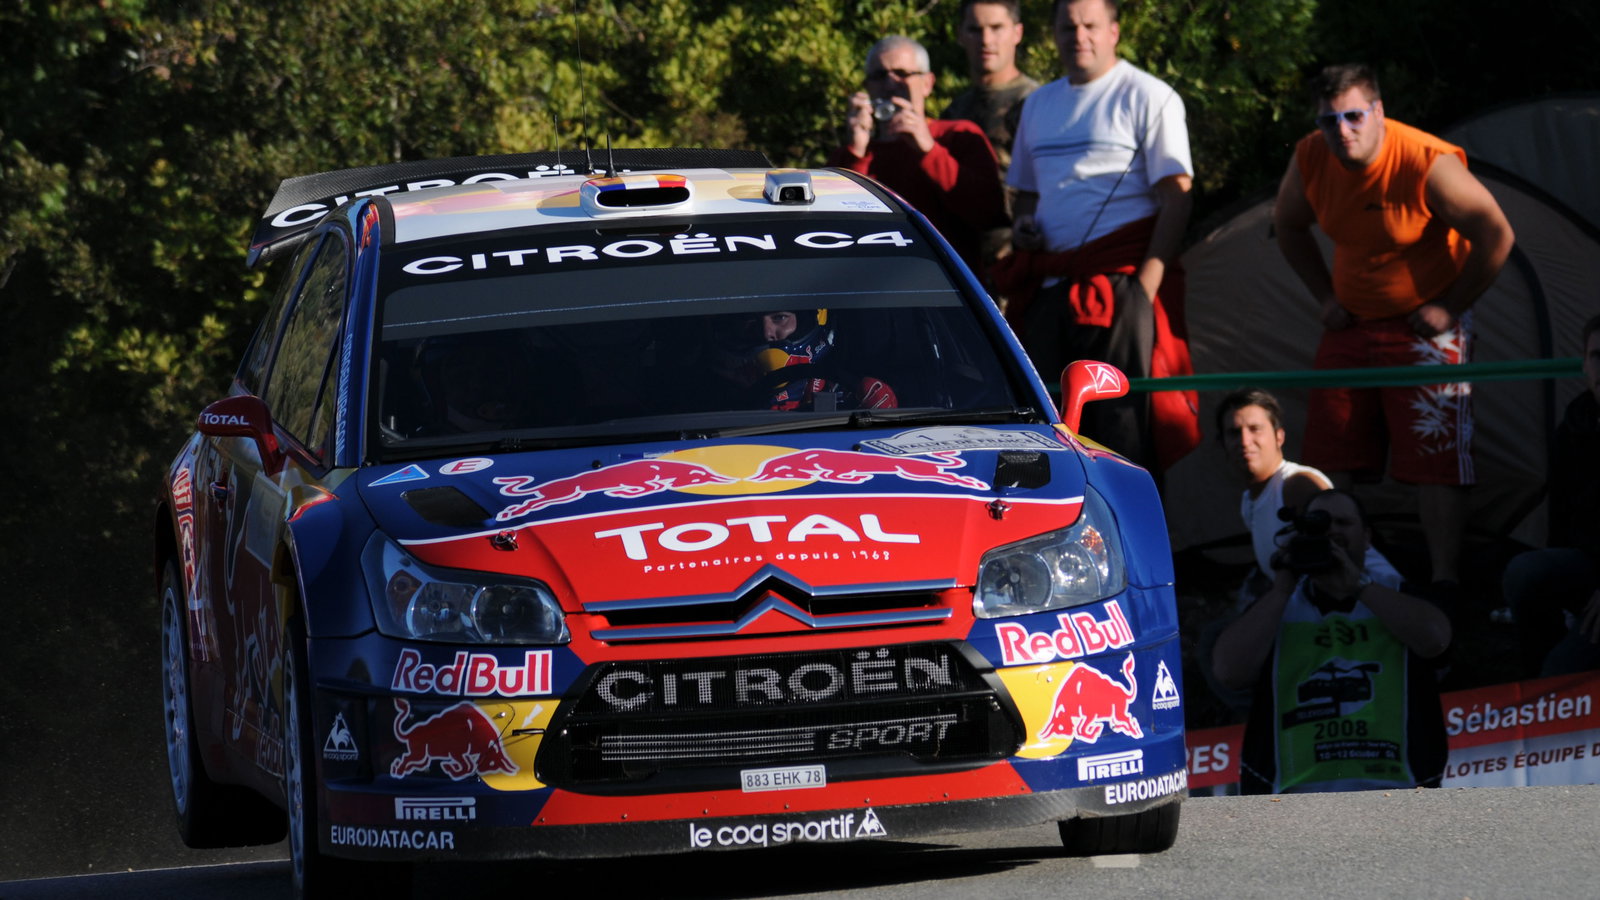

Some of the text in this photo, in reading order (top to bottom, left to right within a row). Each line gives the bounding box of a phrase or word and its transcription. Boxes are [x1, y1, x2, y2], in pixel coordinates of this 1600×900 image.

[402, 231, 913, 275] CITROËN C4
[203, 413, 250, 425] TOTAL
[594, 513, 920, 561] TOTAL
[643, 550, 891, 574] Partenaires depuis 1968
[596, 648, 951, 709] CITROËN
[1314, 719, 1368, 739] 2008
[1446, 692, 1592, 736] Sébastien
[827, 719, 957, 750] SPORT
[1077, 749, 1143, 781] PIRELLI
[1186, 743, 1229, 774] ES
[1514, 745, 1586, 769] ÉQUIPE
[746, 770, 821, 788] 883 EHK 78
[394, 797, 476, 820] PIRELLI
[330, 824, 455, 850] EURODATACAR
[689, 813, 855, 848] le coq sportif
